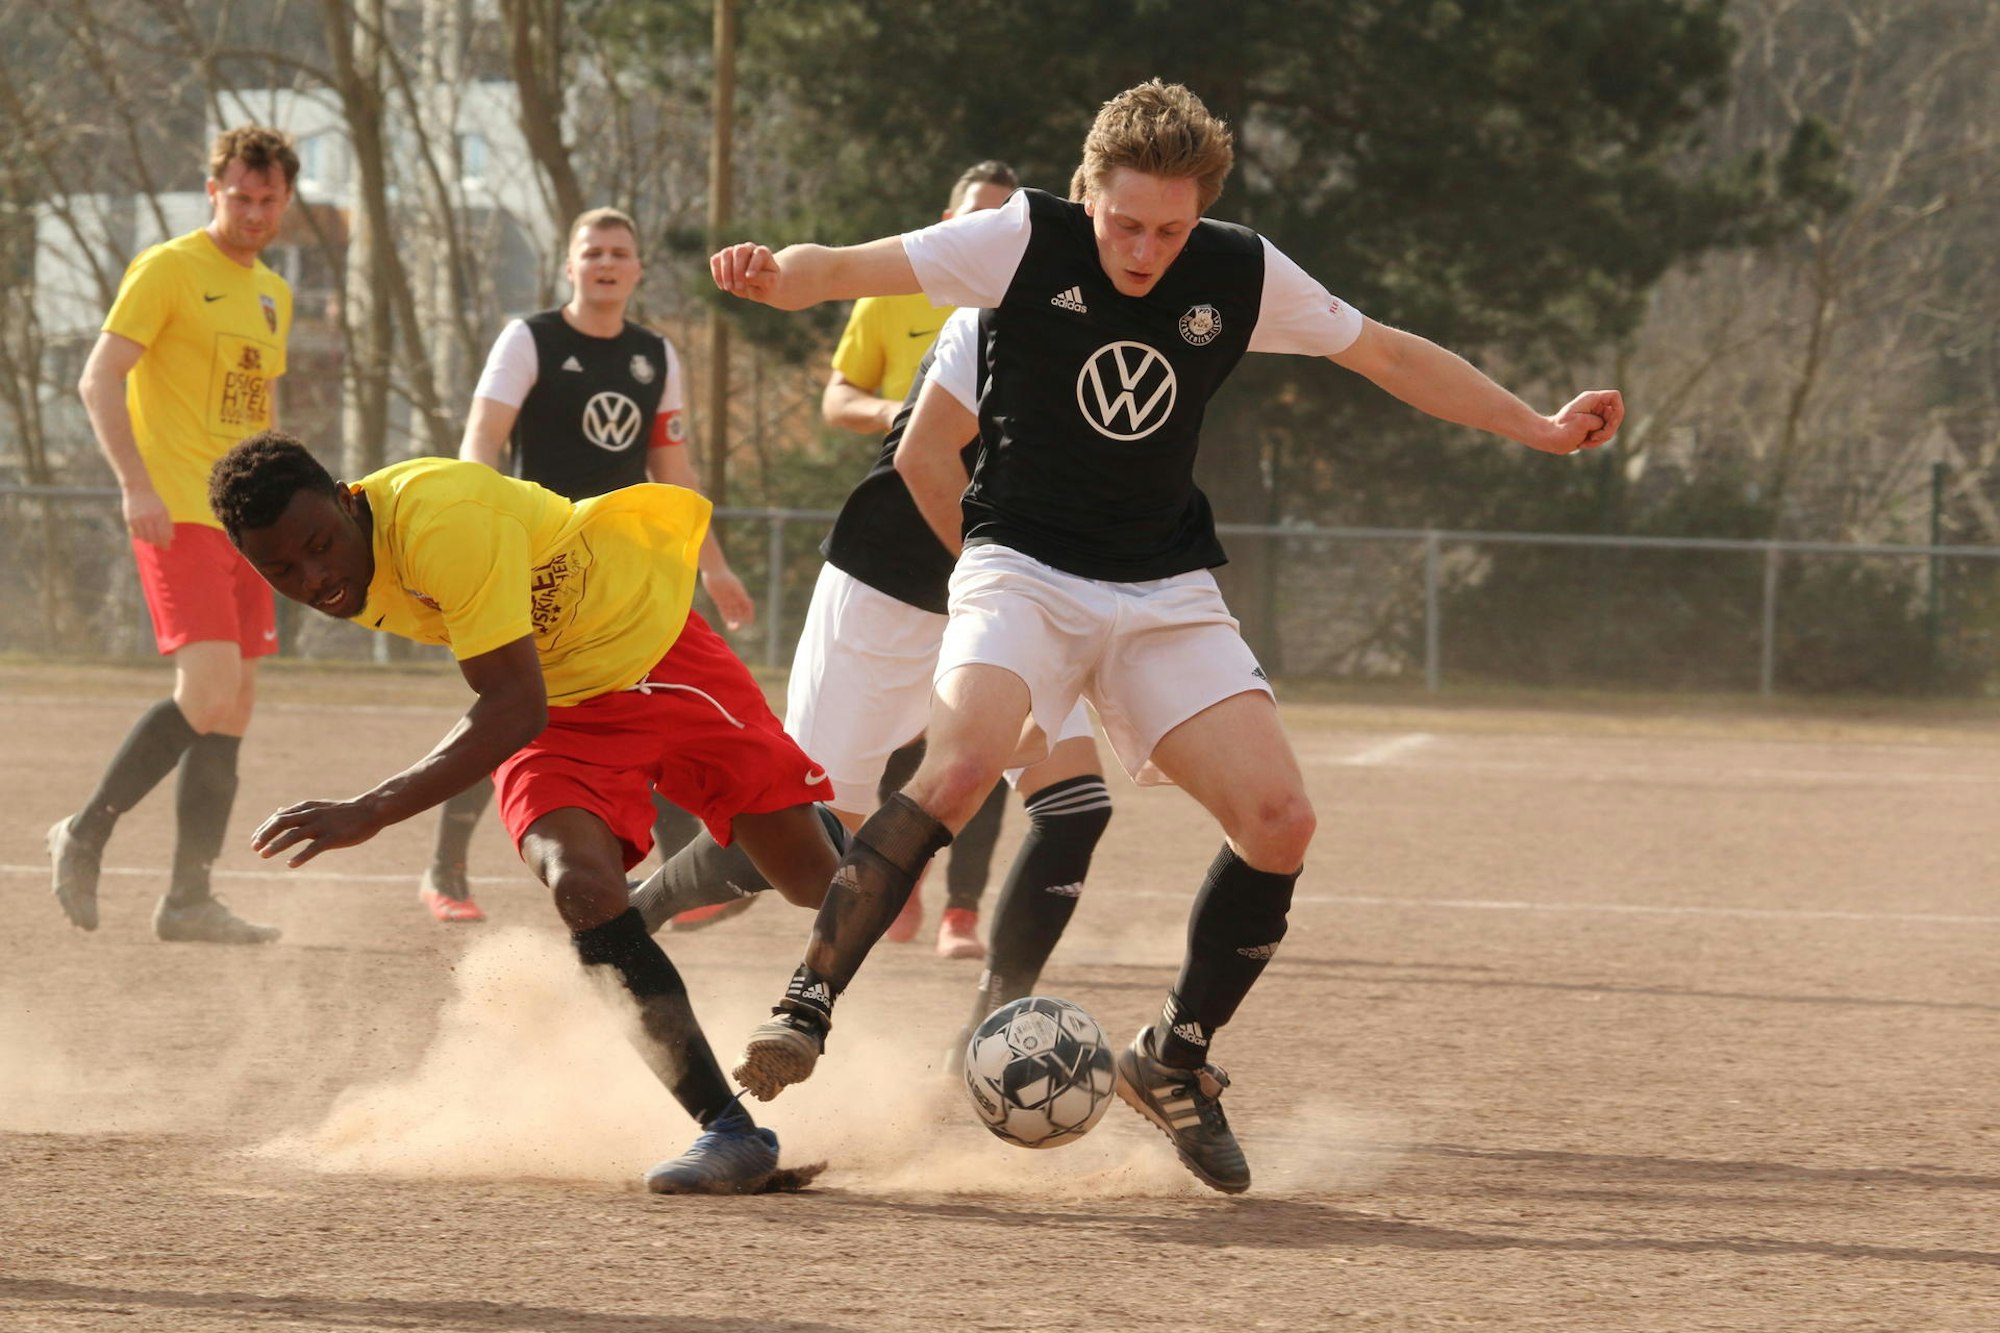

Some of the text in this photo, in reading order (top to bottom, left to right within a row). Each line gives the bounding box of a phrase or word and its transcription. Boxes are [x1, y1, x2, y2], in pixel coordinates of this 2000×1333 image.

[1051, 297, 1087, 313] adidas
[221, 387, 267, 415] HTEL
[1077, 341, 1177, 441] VW
[583, 391, 642, 452] VW
[1173, 1025, 1208, 1048] adidas
